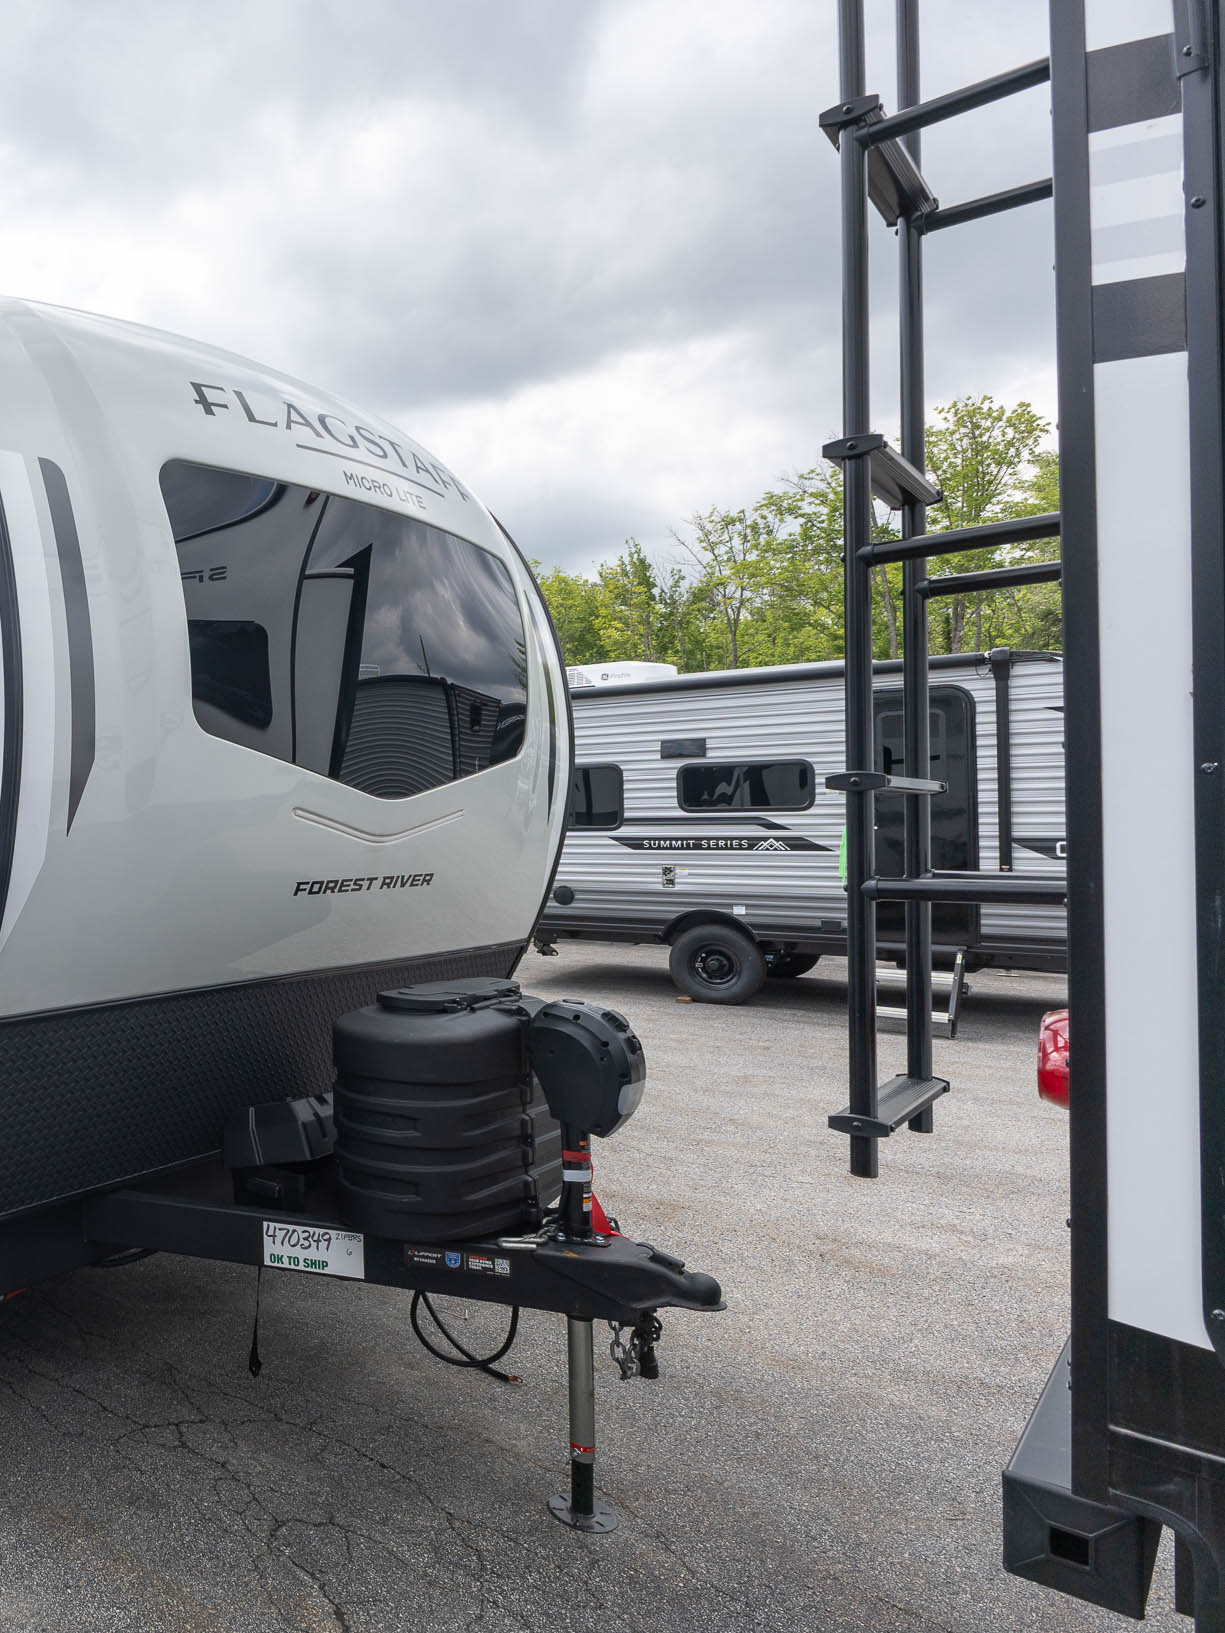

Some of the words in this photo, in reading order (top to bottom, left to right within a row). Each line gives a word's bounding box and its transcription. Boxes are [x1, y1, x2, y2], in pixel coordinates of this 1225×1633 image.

[189, 381, 471, 503] FLAGSTAFF
[342, 470, 393, 498] MICRO
[395, 487, 427, 510] LITE
[642, 839, 696, 849] SUMMIT
[701, 839, 749, 849] SERIES
[292, 876, 379, 897] FOREST
[379, 872, 435, 891] RIVER
[264, 1223, 333, 1252] 470349
[269, 1252, 284, 1265] OK
[287, 1254, 300, 1268] TO
[303, 1257, 329, 1271] SHIP
